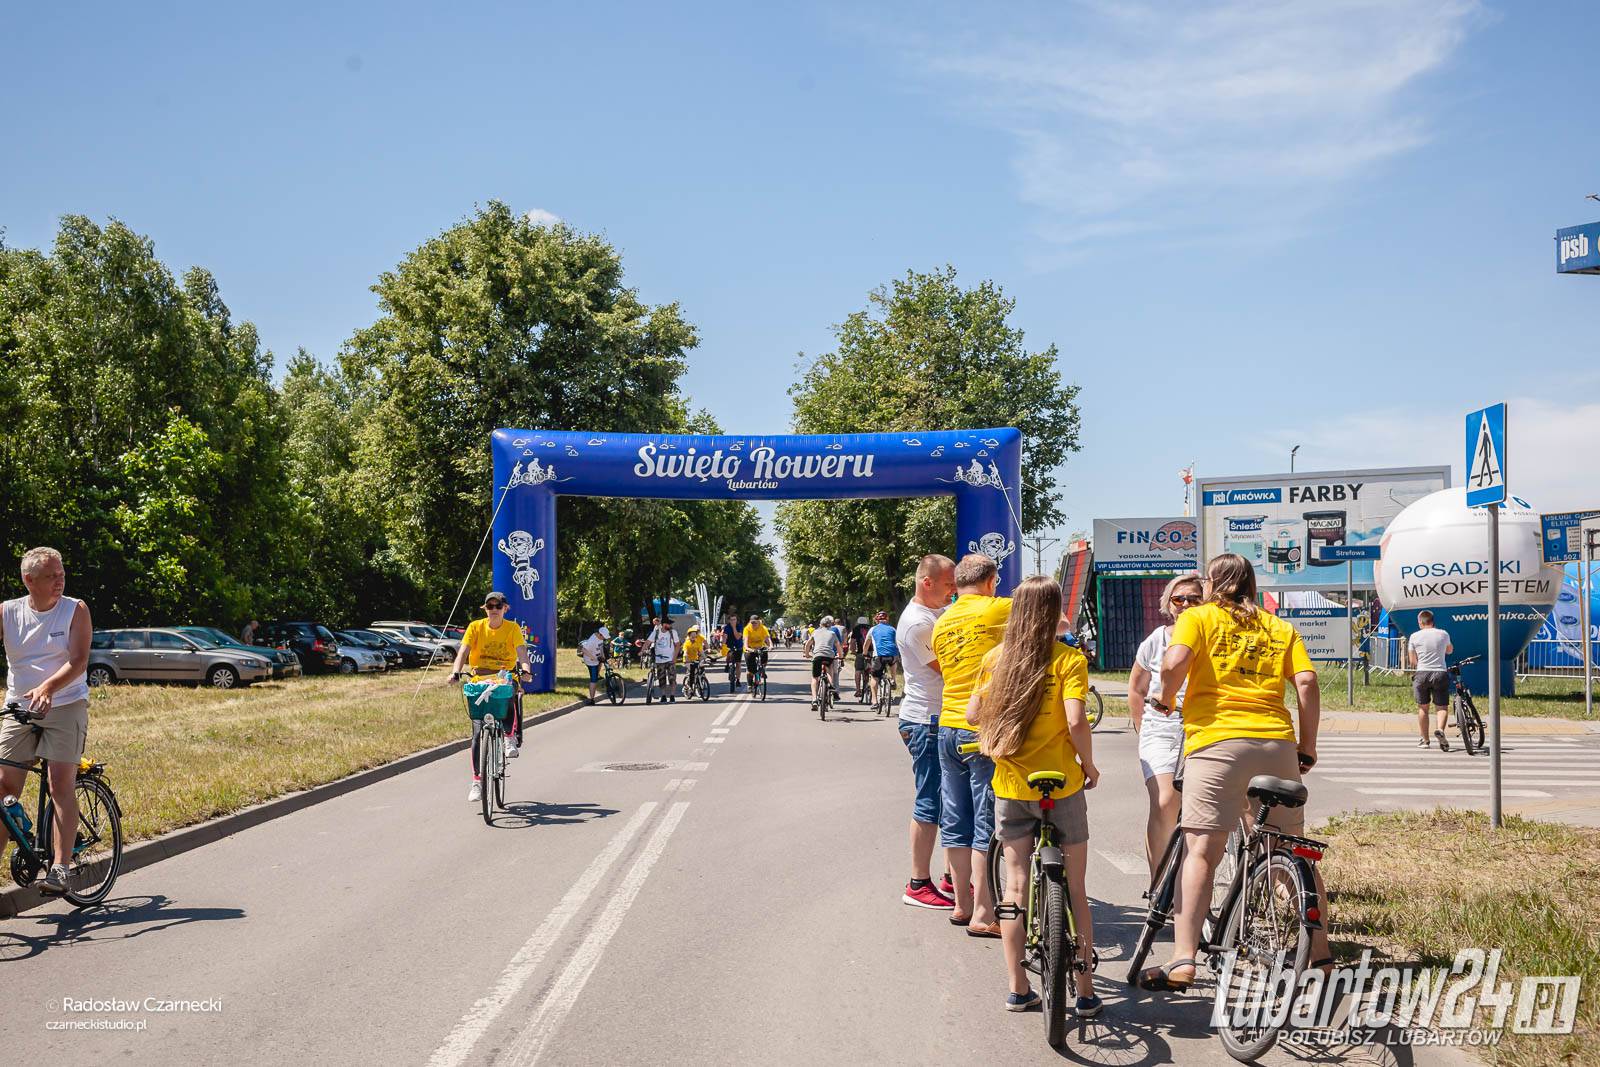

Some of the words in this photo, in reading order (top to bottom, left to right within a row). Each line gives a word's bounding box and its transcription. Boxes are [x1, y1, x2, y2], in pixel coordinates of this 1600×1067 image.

[1561, 233, 1589, 264] psb
[633, 441, 741, 482] Święto
[750, 446, 874, 479] Roweru
[726, 477, 778, 492] Lubartów
[1289, 483, 1363, 503] FARBY
[1233, 491, 1276, 501] MRÓWKA
[1336, 549, 1365, 557] Strefowa
